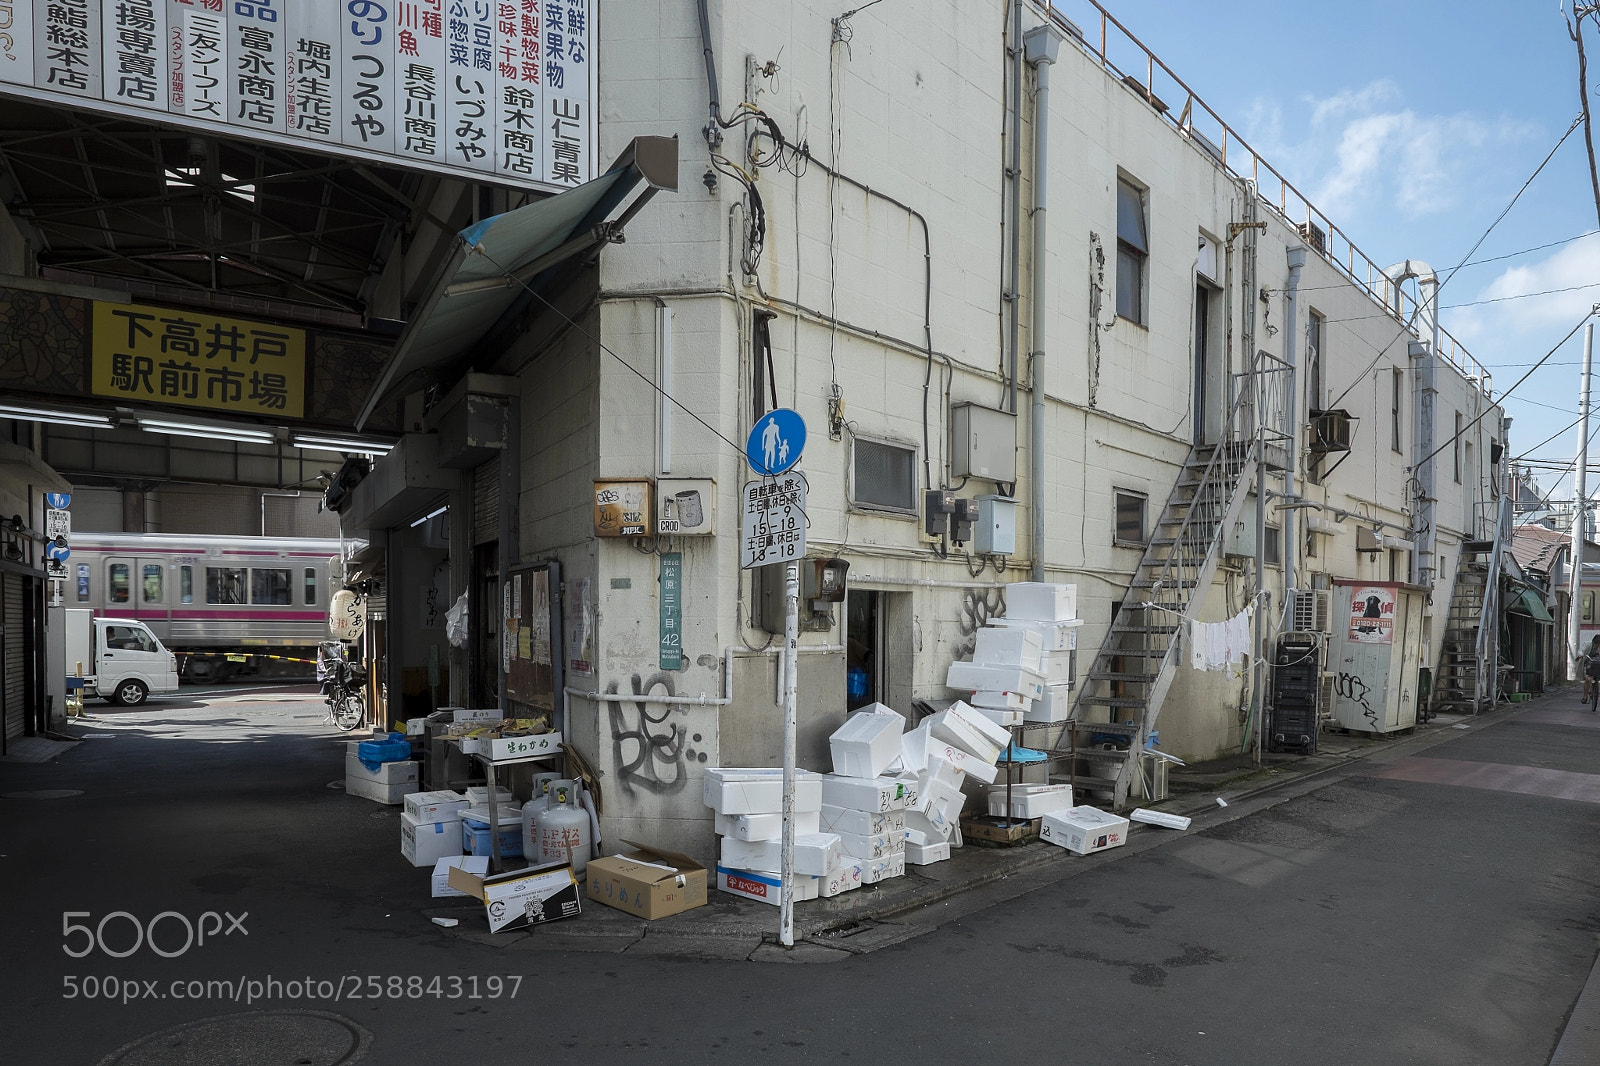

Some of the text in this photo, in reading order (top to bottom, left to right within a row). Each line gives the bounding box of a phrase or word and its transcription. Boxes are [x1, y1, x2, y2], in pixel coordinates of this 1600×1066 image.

[116, 0, 157, 101] 揚専賣店
[189, 15, 222, 117] 三友シーフーズ
[238, 25, 275, 125] 富永商店
[296, 37, 332, 136] 堀内生花店
[546, 0, 564, 90] 菜果物
[351, 54, 385, 142] つるや
[403, 62, 436, 156] 長谷川商店
[455, 74, 487, 163] いづみや
[503, 85, 535, 175] 鈴木商店
[551, 98, 581, 184] 山仁青果
[112, 309, 290, 364] 下高井戸
[110, 353, 288, 410] 駅前市場
[661, 634, 679, 646] 42
[664, 567, 676, 629] 松原三丁目
[507, 738, 549, 754] 生わかめ
[592, 878, 643, 909] ちりめん
